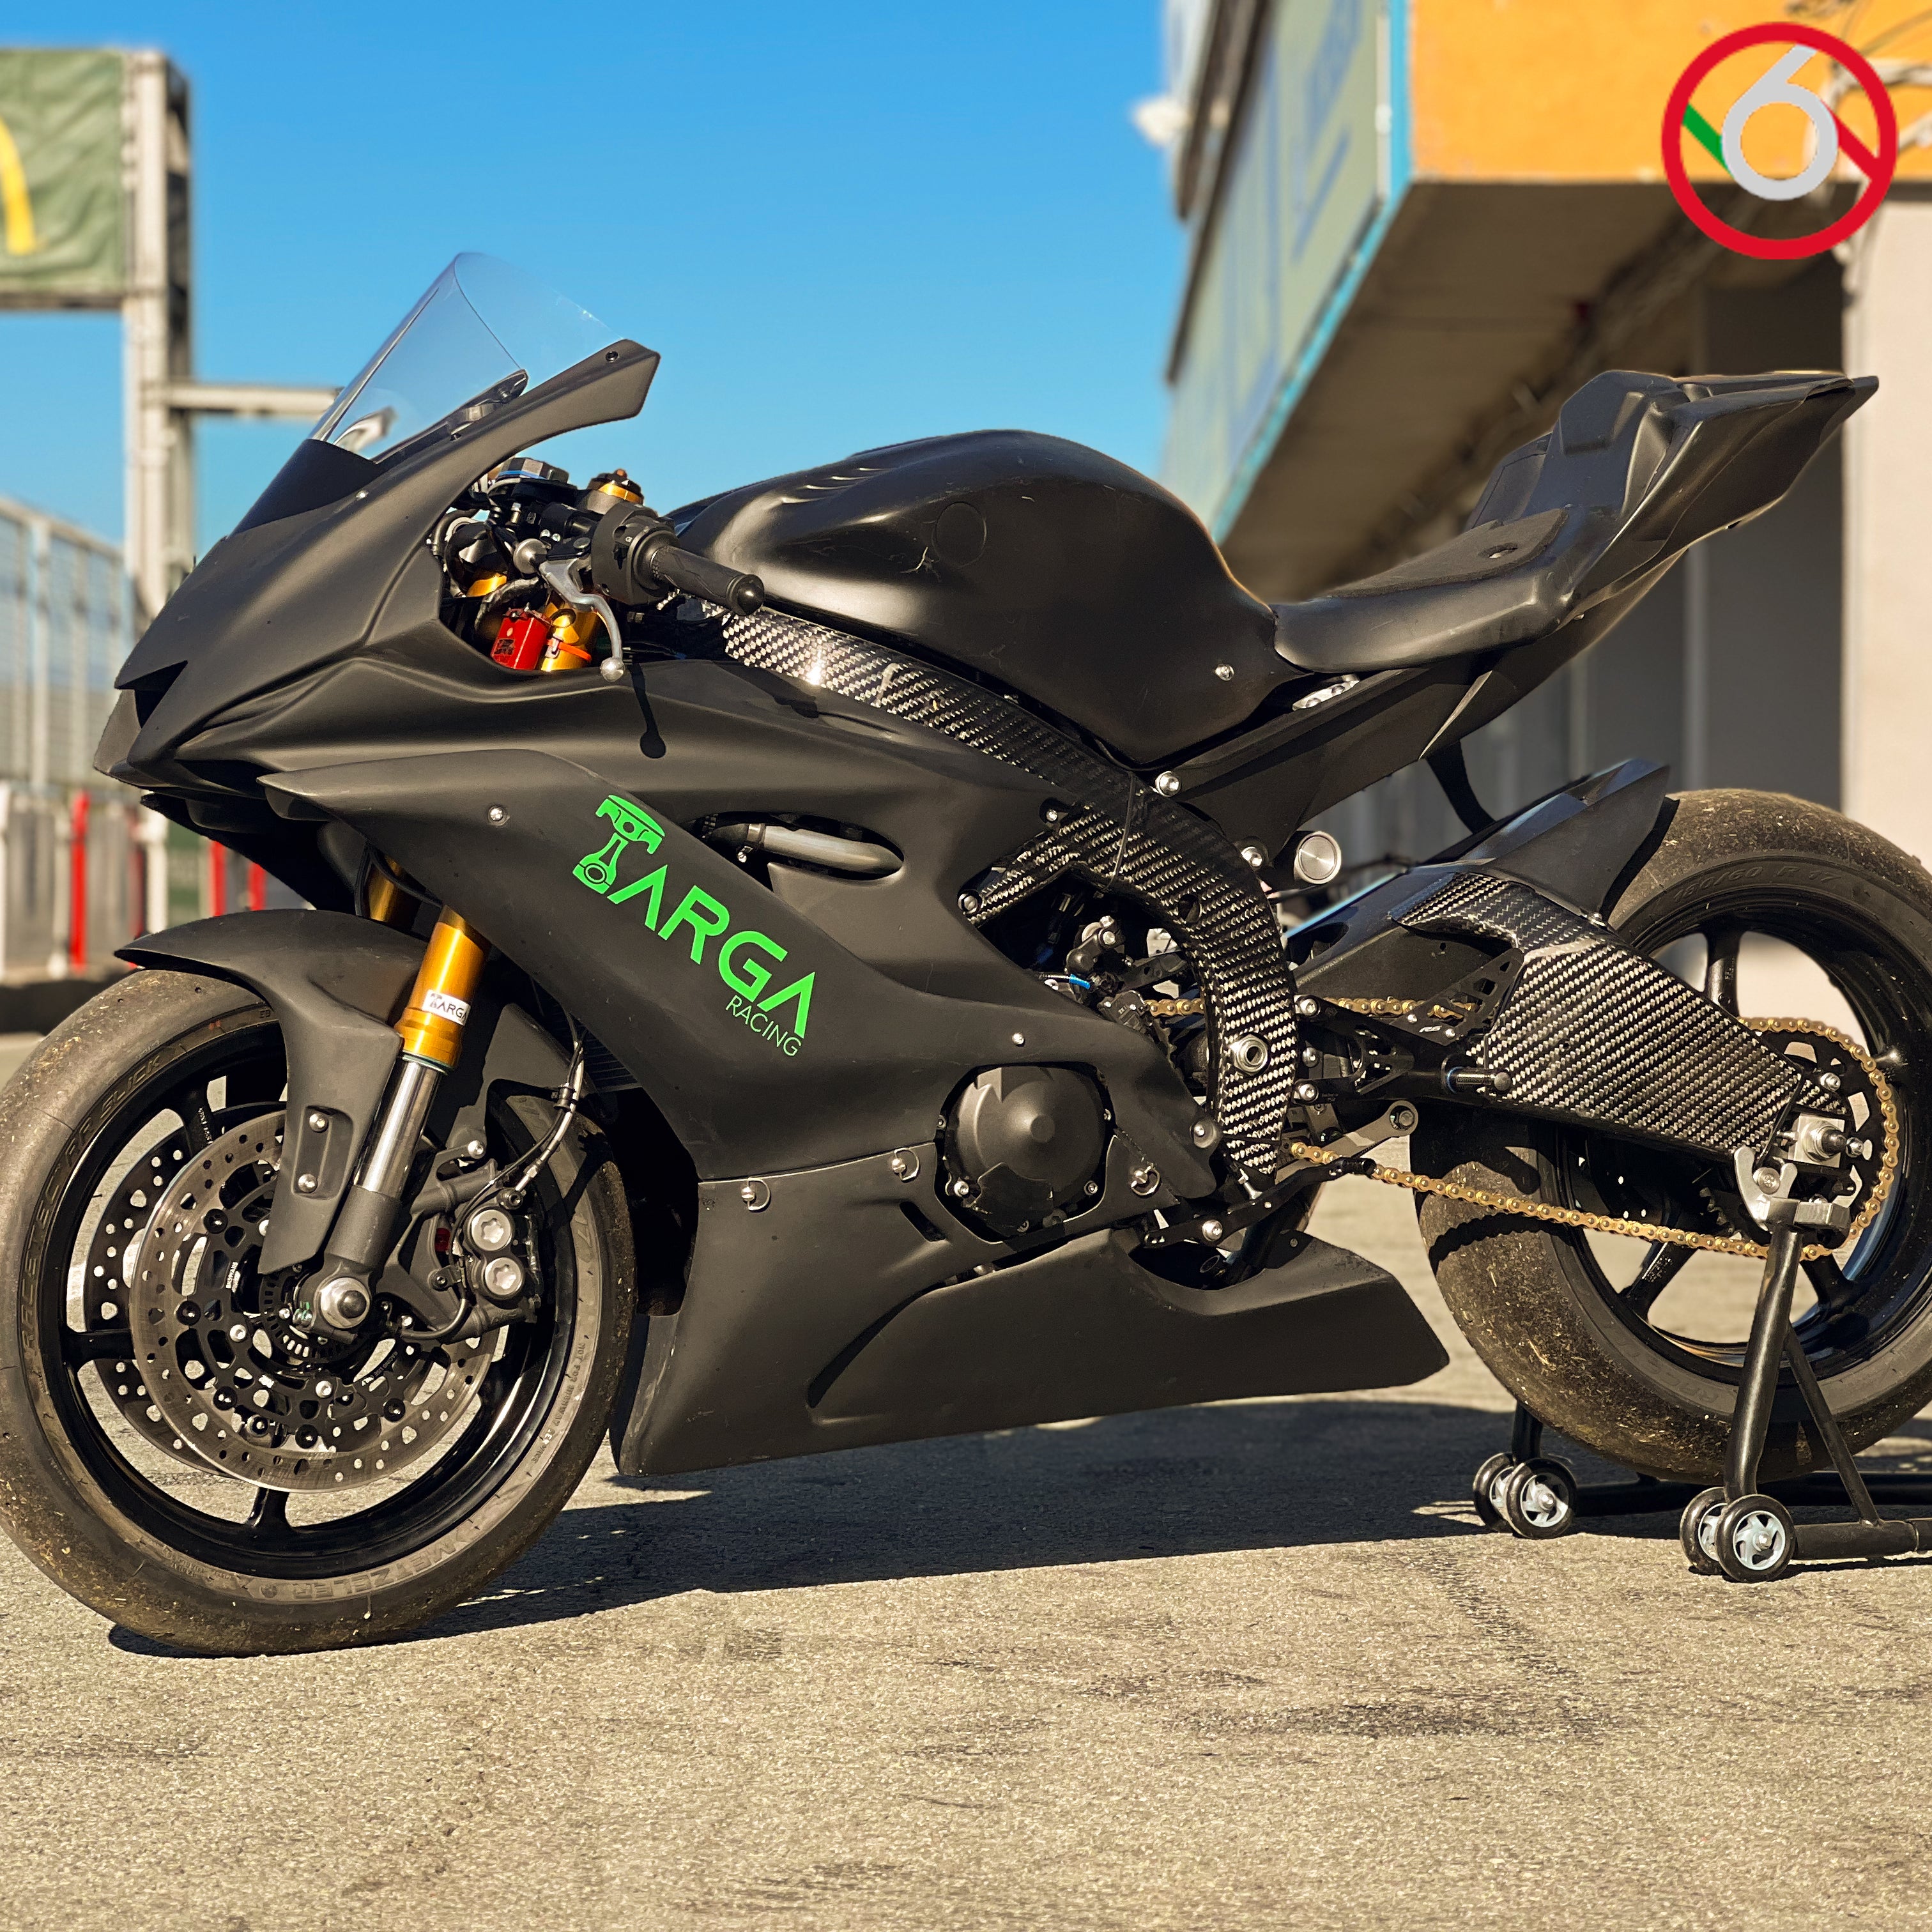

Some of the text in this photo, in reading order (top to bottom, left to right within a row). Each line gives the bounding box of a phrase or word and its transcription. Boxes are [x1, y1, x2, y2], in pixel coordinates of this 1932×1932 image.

[572, 795, 816, 1039] TARGA
[726, 995, 802, 1057] RACING
[101, 1058, 162, 1114] SLICK
[532, 1428, 555, 1464] SERVICE
[291, 1539, 457, 1598] METZELER
